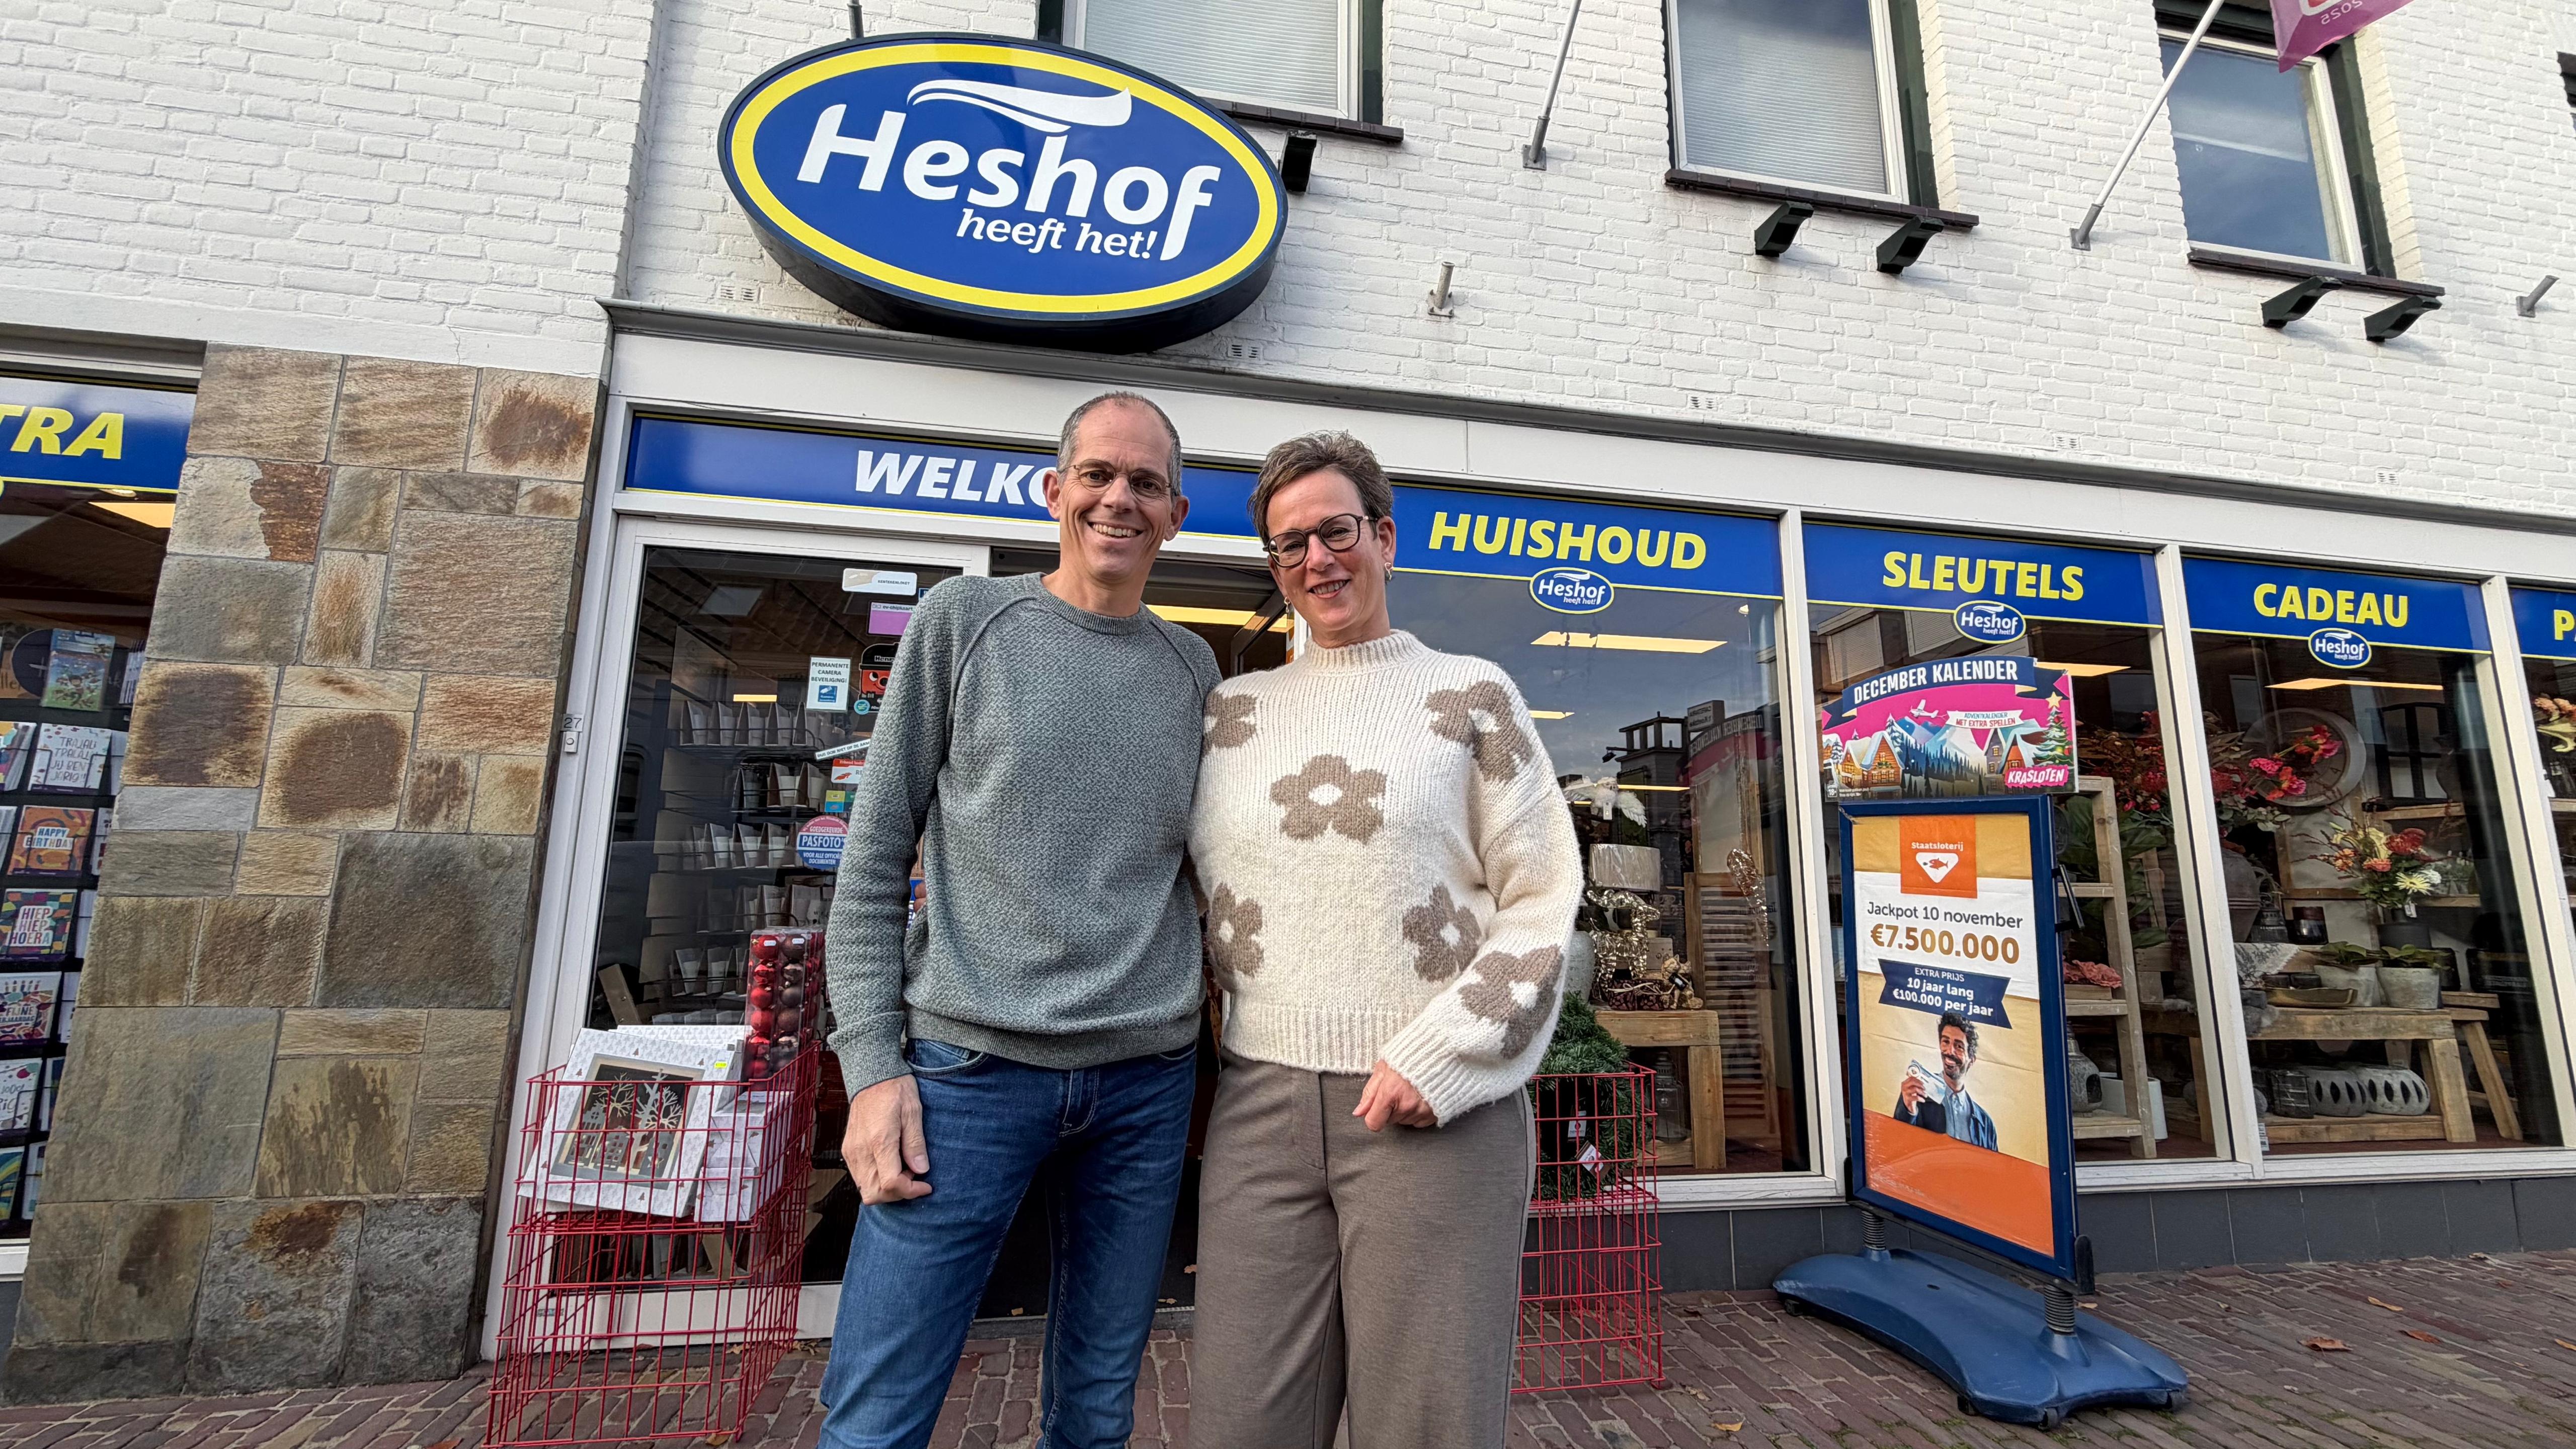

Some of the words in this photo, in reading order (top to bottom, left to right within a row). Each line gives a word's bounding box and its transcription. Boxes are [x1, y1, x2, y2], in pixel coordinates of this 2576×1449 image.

[796, 104, 1220, 261] Heshof
[956, 209, 1067, 253] heeft
[1075, 221, 1159, 260] het!
[1429, 512, 1706, 569] HUISHOUD
[1883, 551, 2083, 601] SLEUTELS
[1538, 579, 1606, 605] Heshof
[1563, 596, 1581, 605] heeft
[2254, 583, 2408, 627] CADEAU
[1961, 612, 2019, 635] Heshof
[2554, 609, 2576, 641] P
[2315, 638, 2364, 660] Heshof
[1854, 664, 1927, 704] DECEMBER
[1933, 660, 2018, 683] KALENDER
[564, 717, 582, 729] 27
[1989, 718, 2016, 727] SPELLEN
[2008, 768, 2065, 784] KRASLOTEN
[26, 837, 72, 848] BIRTHDAY
[38, 828, 66, 837] HAPPY
[1911, 842, 1963, 852] Staatsloterij
[22, 908, 50, 919] HIEP
[1868, 902, 1918, 920] Jackpot
[1922, 906, 1939, 921] 10
[1944, 911, 2023, 928] november
[19, 920, 47, 931] HIEP
[10, 932, 50, 944] HOERA
[1870, 923, 2019, 964] €7.500.000
[1915, 968, 1939, 978] EXTRA
[1942, 972, 1965, 982] PRIJS
[1907, 977, 1920, 989] 10
[1921, 980, 1944, 993] jaar
[1947, 983, 1974, 1001] lang
[6, 1006, 34, 1016] FIJNE
[1893, 988, 1942, 1007] €100.000
[1945, 998, 1967, 1011] per
[1967, 1002, 1993, 1016] jaar
